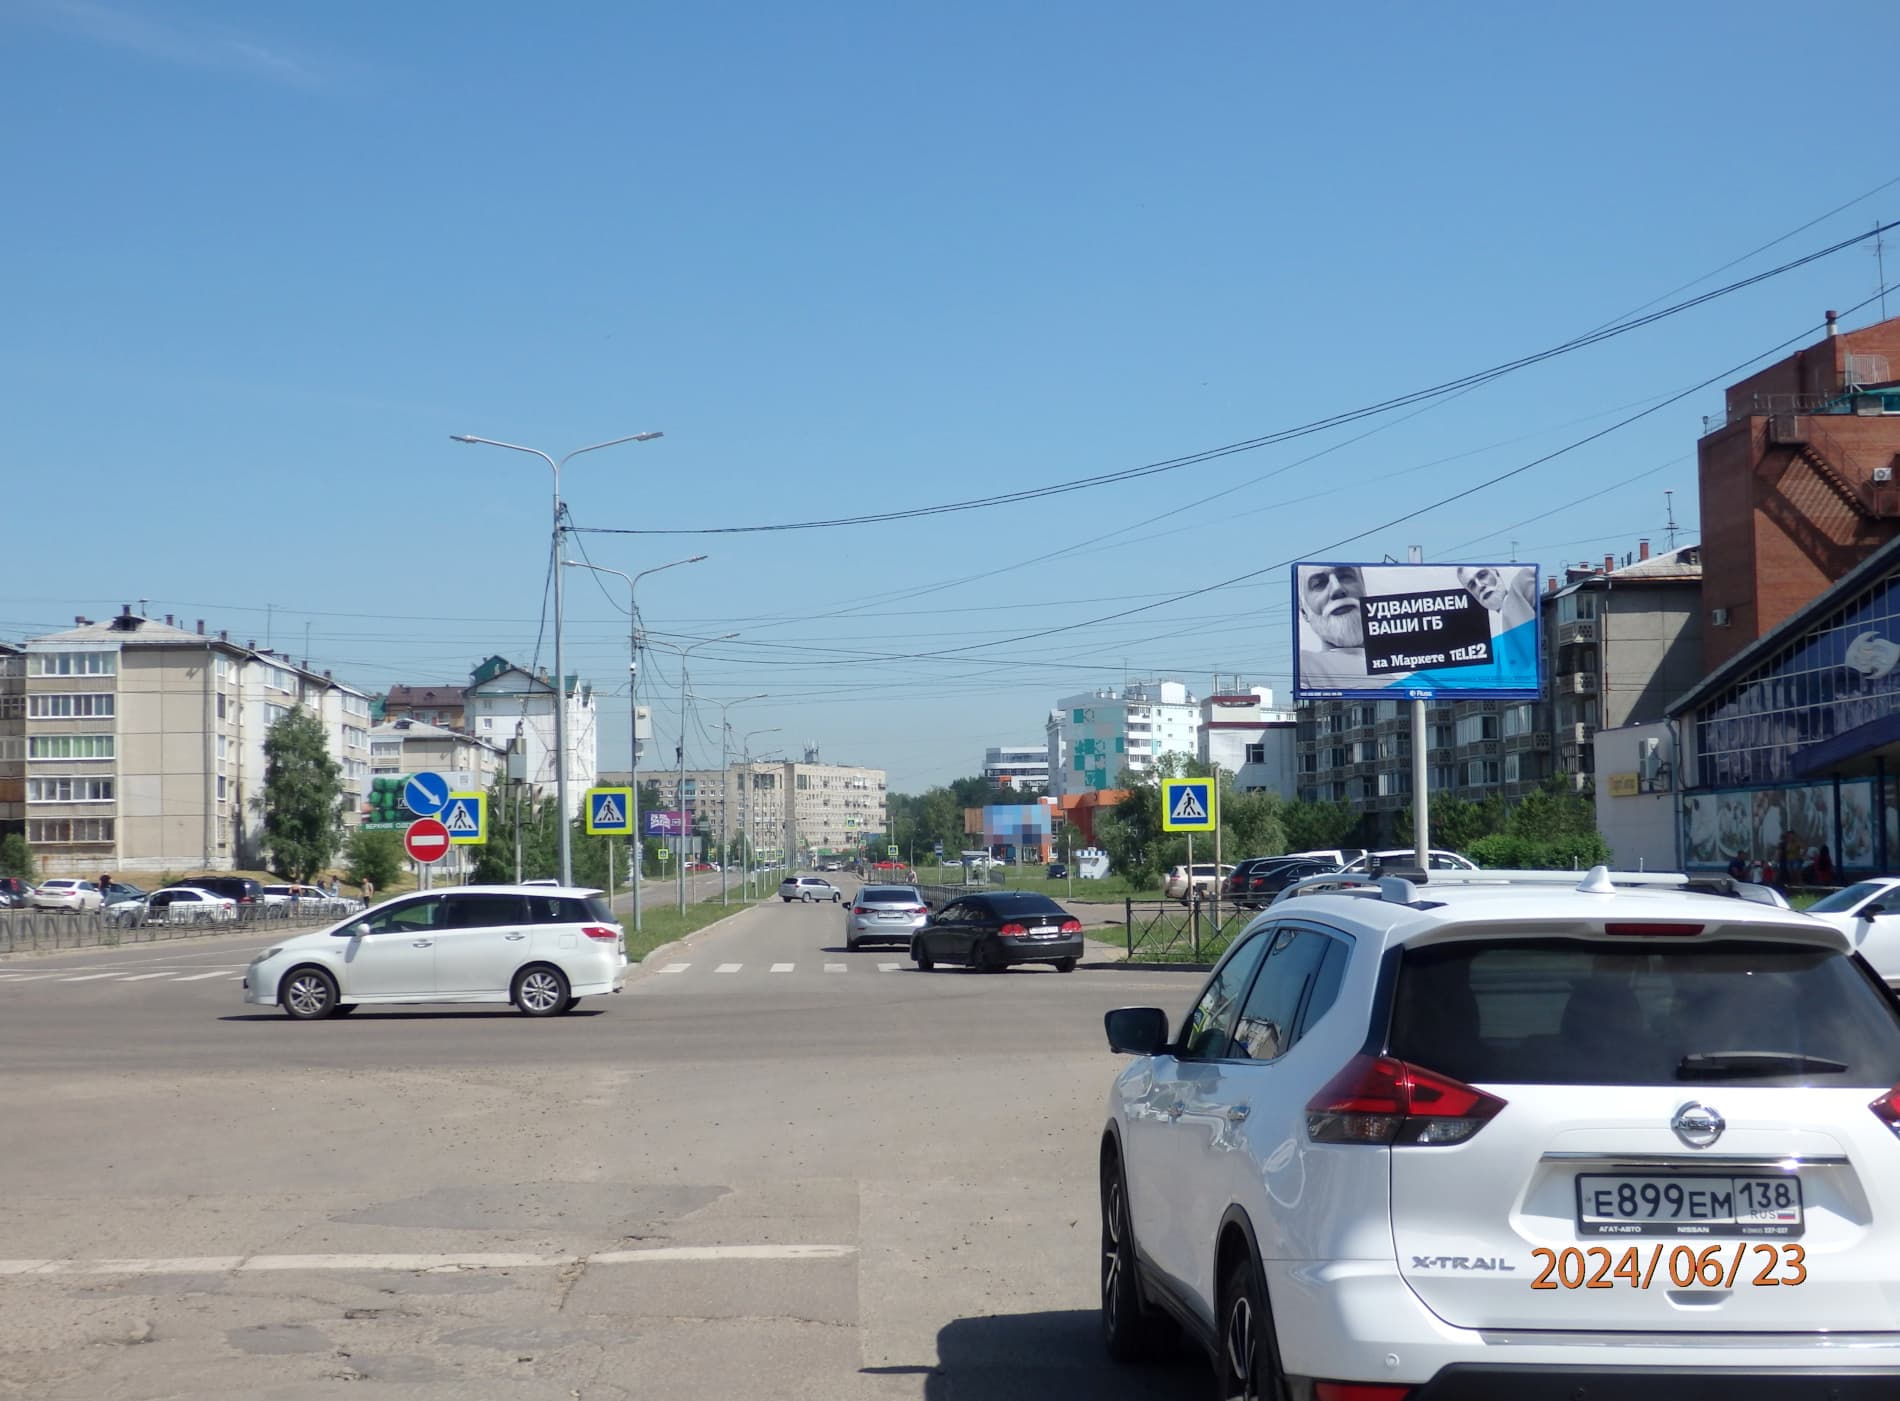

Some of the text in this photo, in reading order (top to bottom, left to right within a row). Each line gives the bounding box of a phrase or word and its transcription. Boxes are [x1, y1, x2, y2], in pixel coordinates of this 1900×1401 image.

[1366, 594, 1469, 619] УДВАИВАЕМ
[1368, 615, 1444, 636] ВАШИ ГБ
[1449, 643, 1488, 661] TELE2
[1372, 653, 1446, 669] на Маркете
[1738, 1182, 1791, 1209] 138
[1750, 1209, 1777, 1220] RUS
[1599, 1225, 1642, 1234] АГАТ-АВТО
[1676, 1226, 1710, 1234] NISSAN
[1411, 1255, 1516, 1272] X-TRAIL
